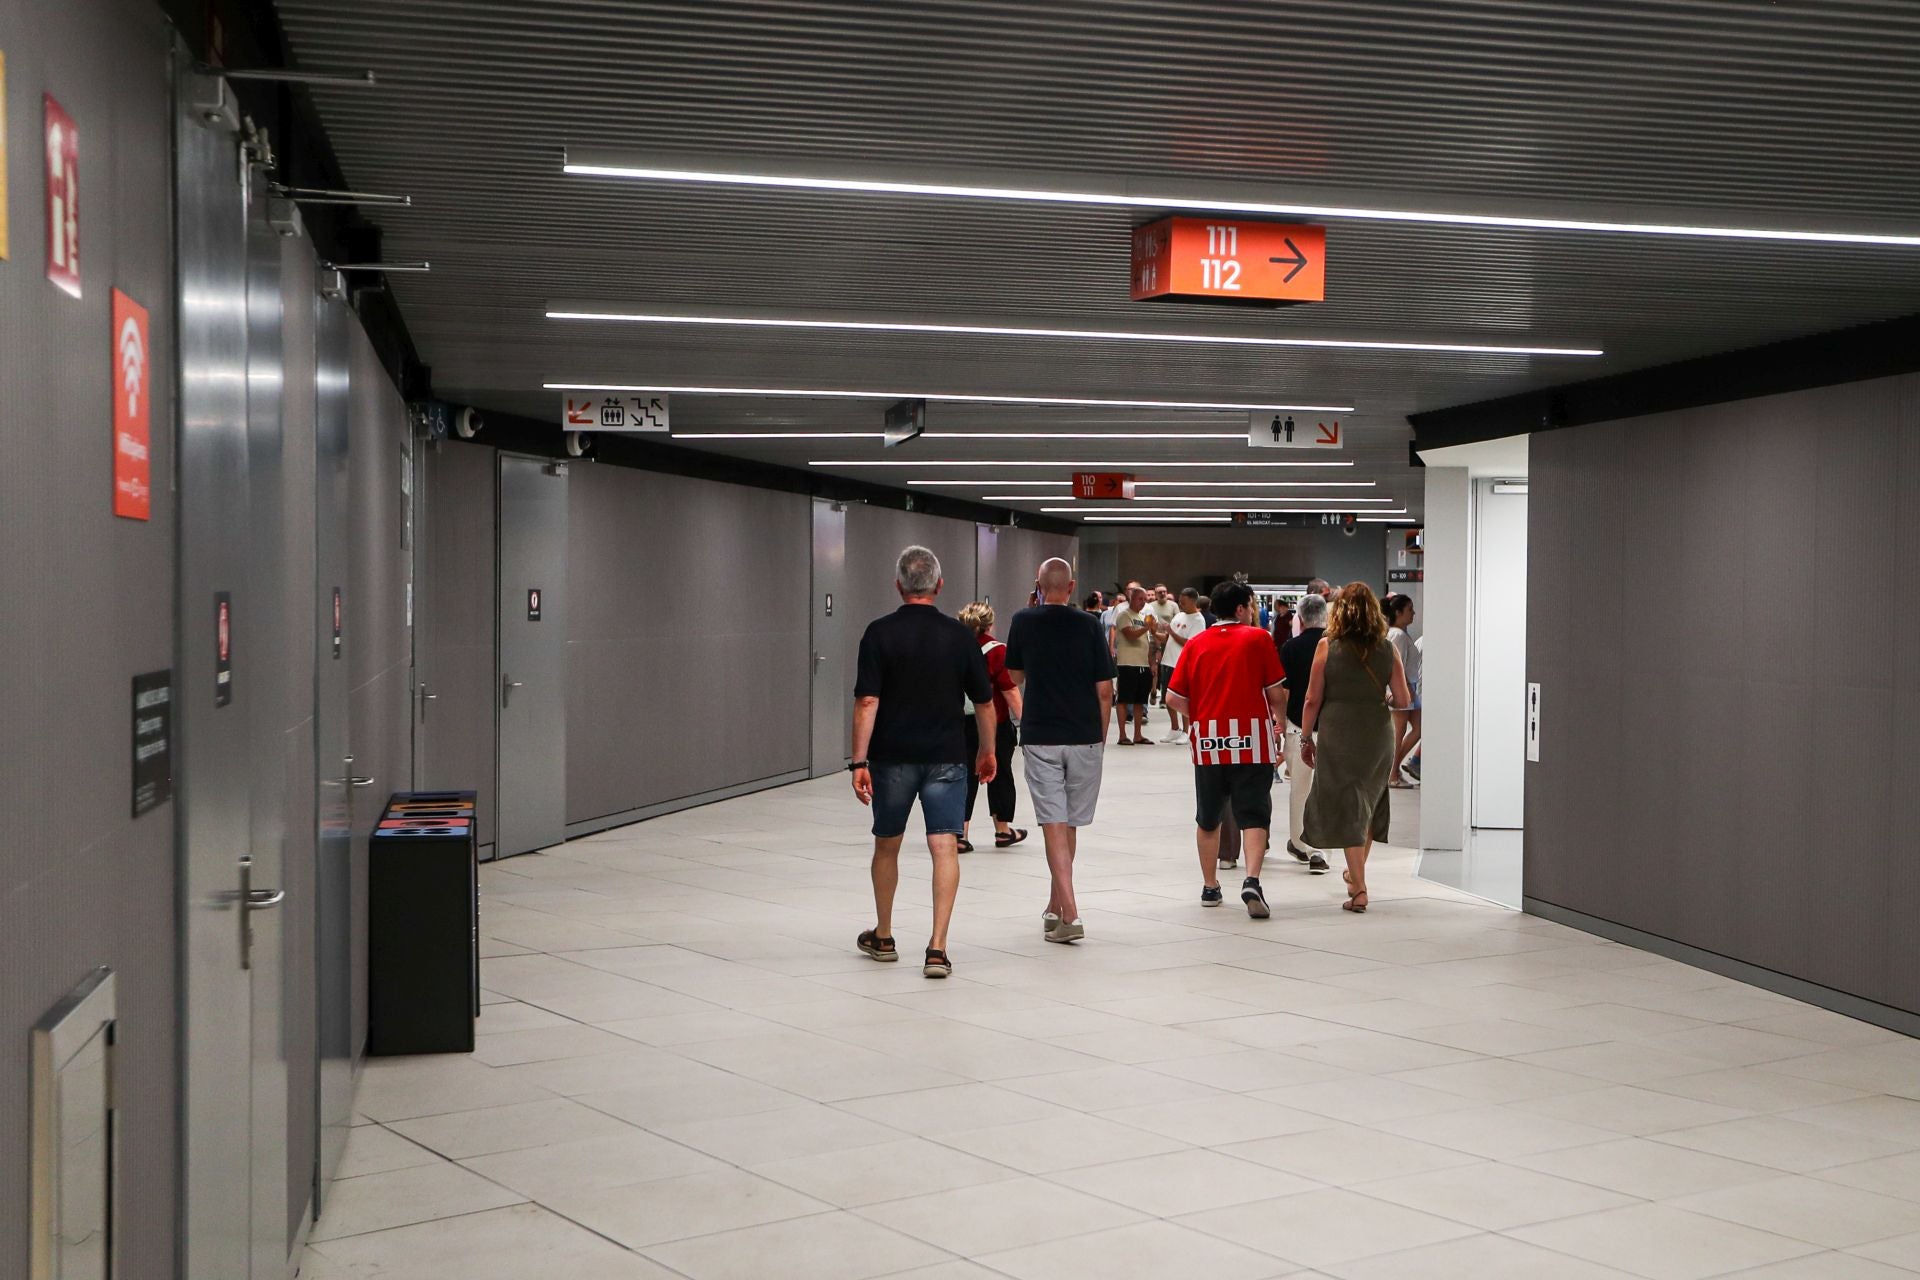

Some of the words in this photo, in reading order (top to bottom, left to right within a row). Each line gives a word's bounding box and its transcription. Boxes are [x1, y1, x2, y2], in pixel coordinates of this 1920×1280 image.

[1206, 225, 1237, 256] 111
[1200, 258, 1241, 290] 112
[1081, 475, 1096, 485] 110
[1083, 486, 1094, 496] 111
[1200, 736, 1252, 751] DIGI
